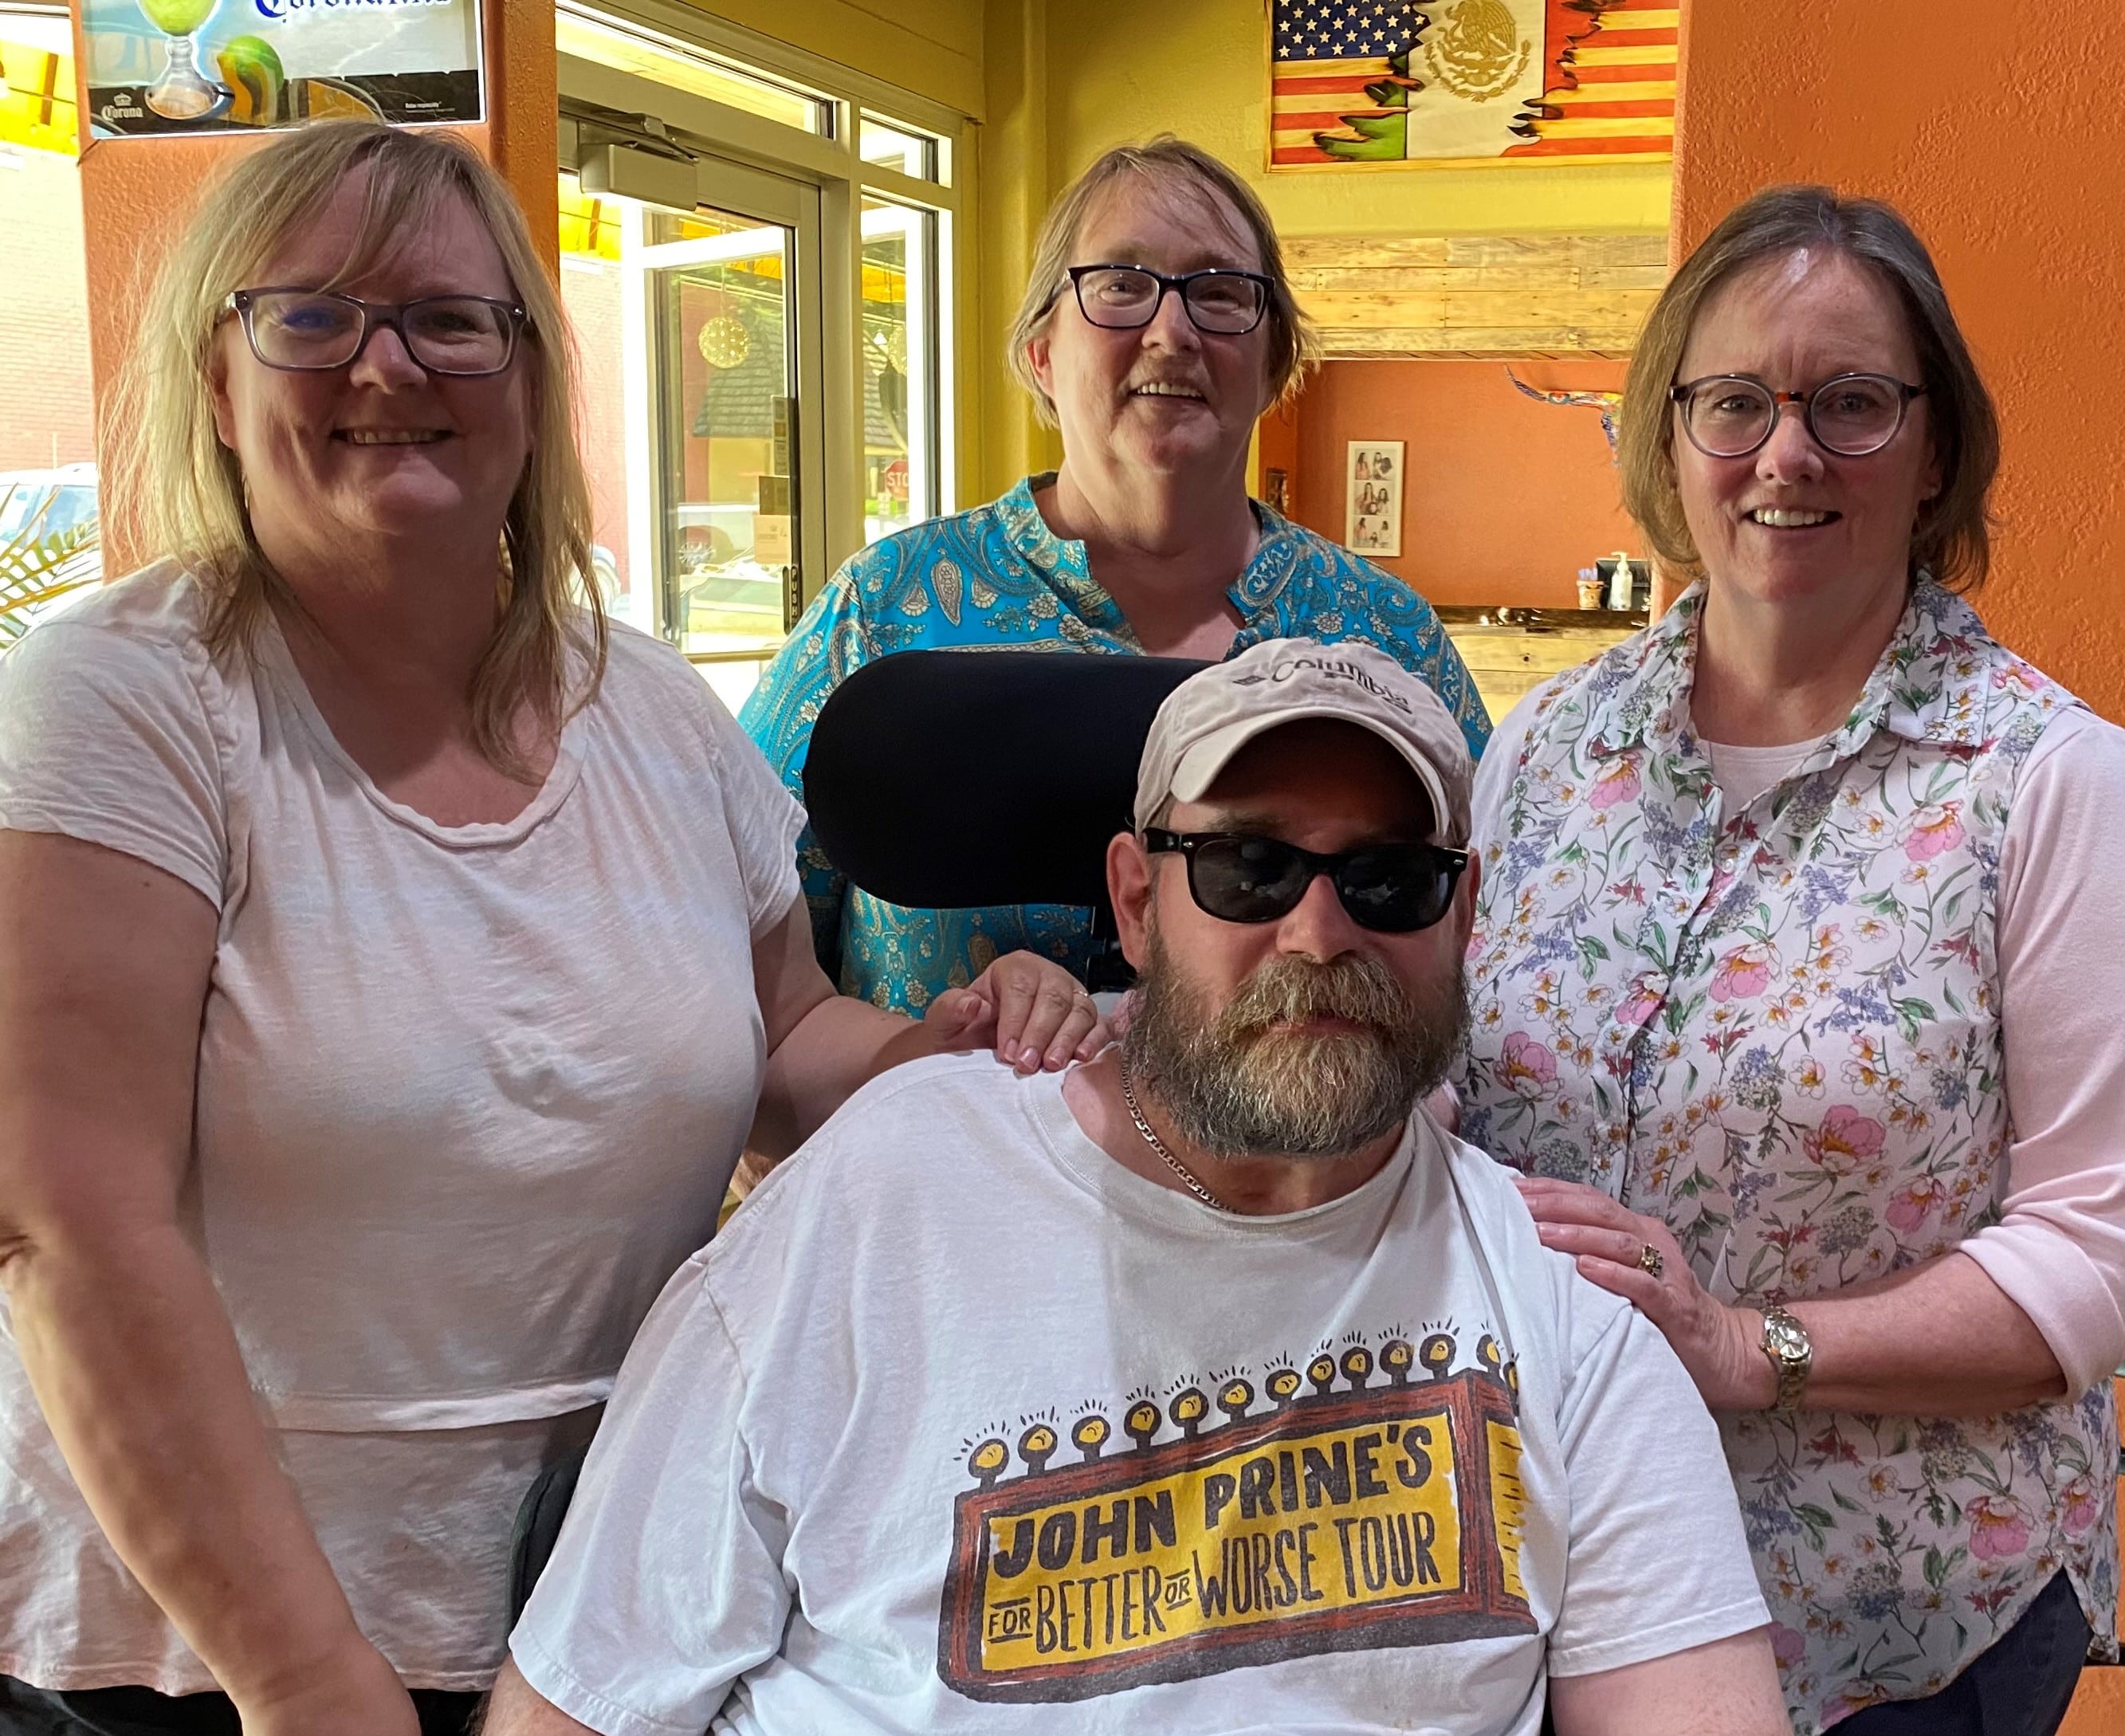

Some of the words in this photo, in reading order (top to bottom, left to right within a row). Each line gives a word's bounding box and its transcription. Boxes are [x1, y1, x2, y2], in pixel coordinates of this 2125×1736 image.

[101, 105, 143, 122] Corona
[886, 471, 909, 487] STO
[993, 1489, 1176, 1579] JOHN
[1204, 1424, 1433, 1530] PRINE'S
[988, 1605, 1031, 1637] FOR
[1035, 1565, 1167, 1655] BETTER
[1165, 1575, 1191, 1604] OR
[1192, 1522, 1325, 1619] WORSE
[1332, 1510, 1441, 1598] TOUR
